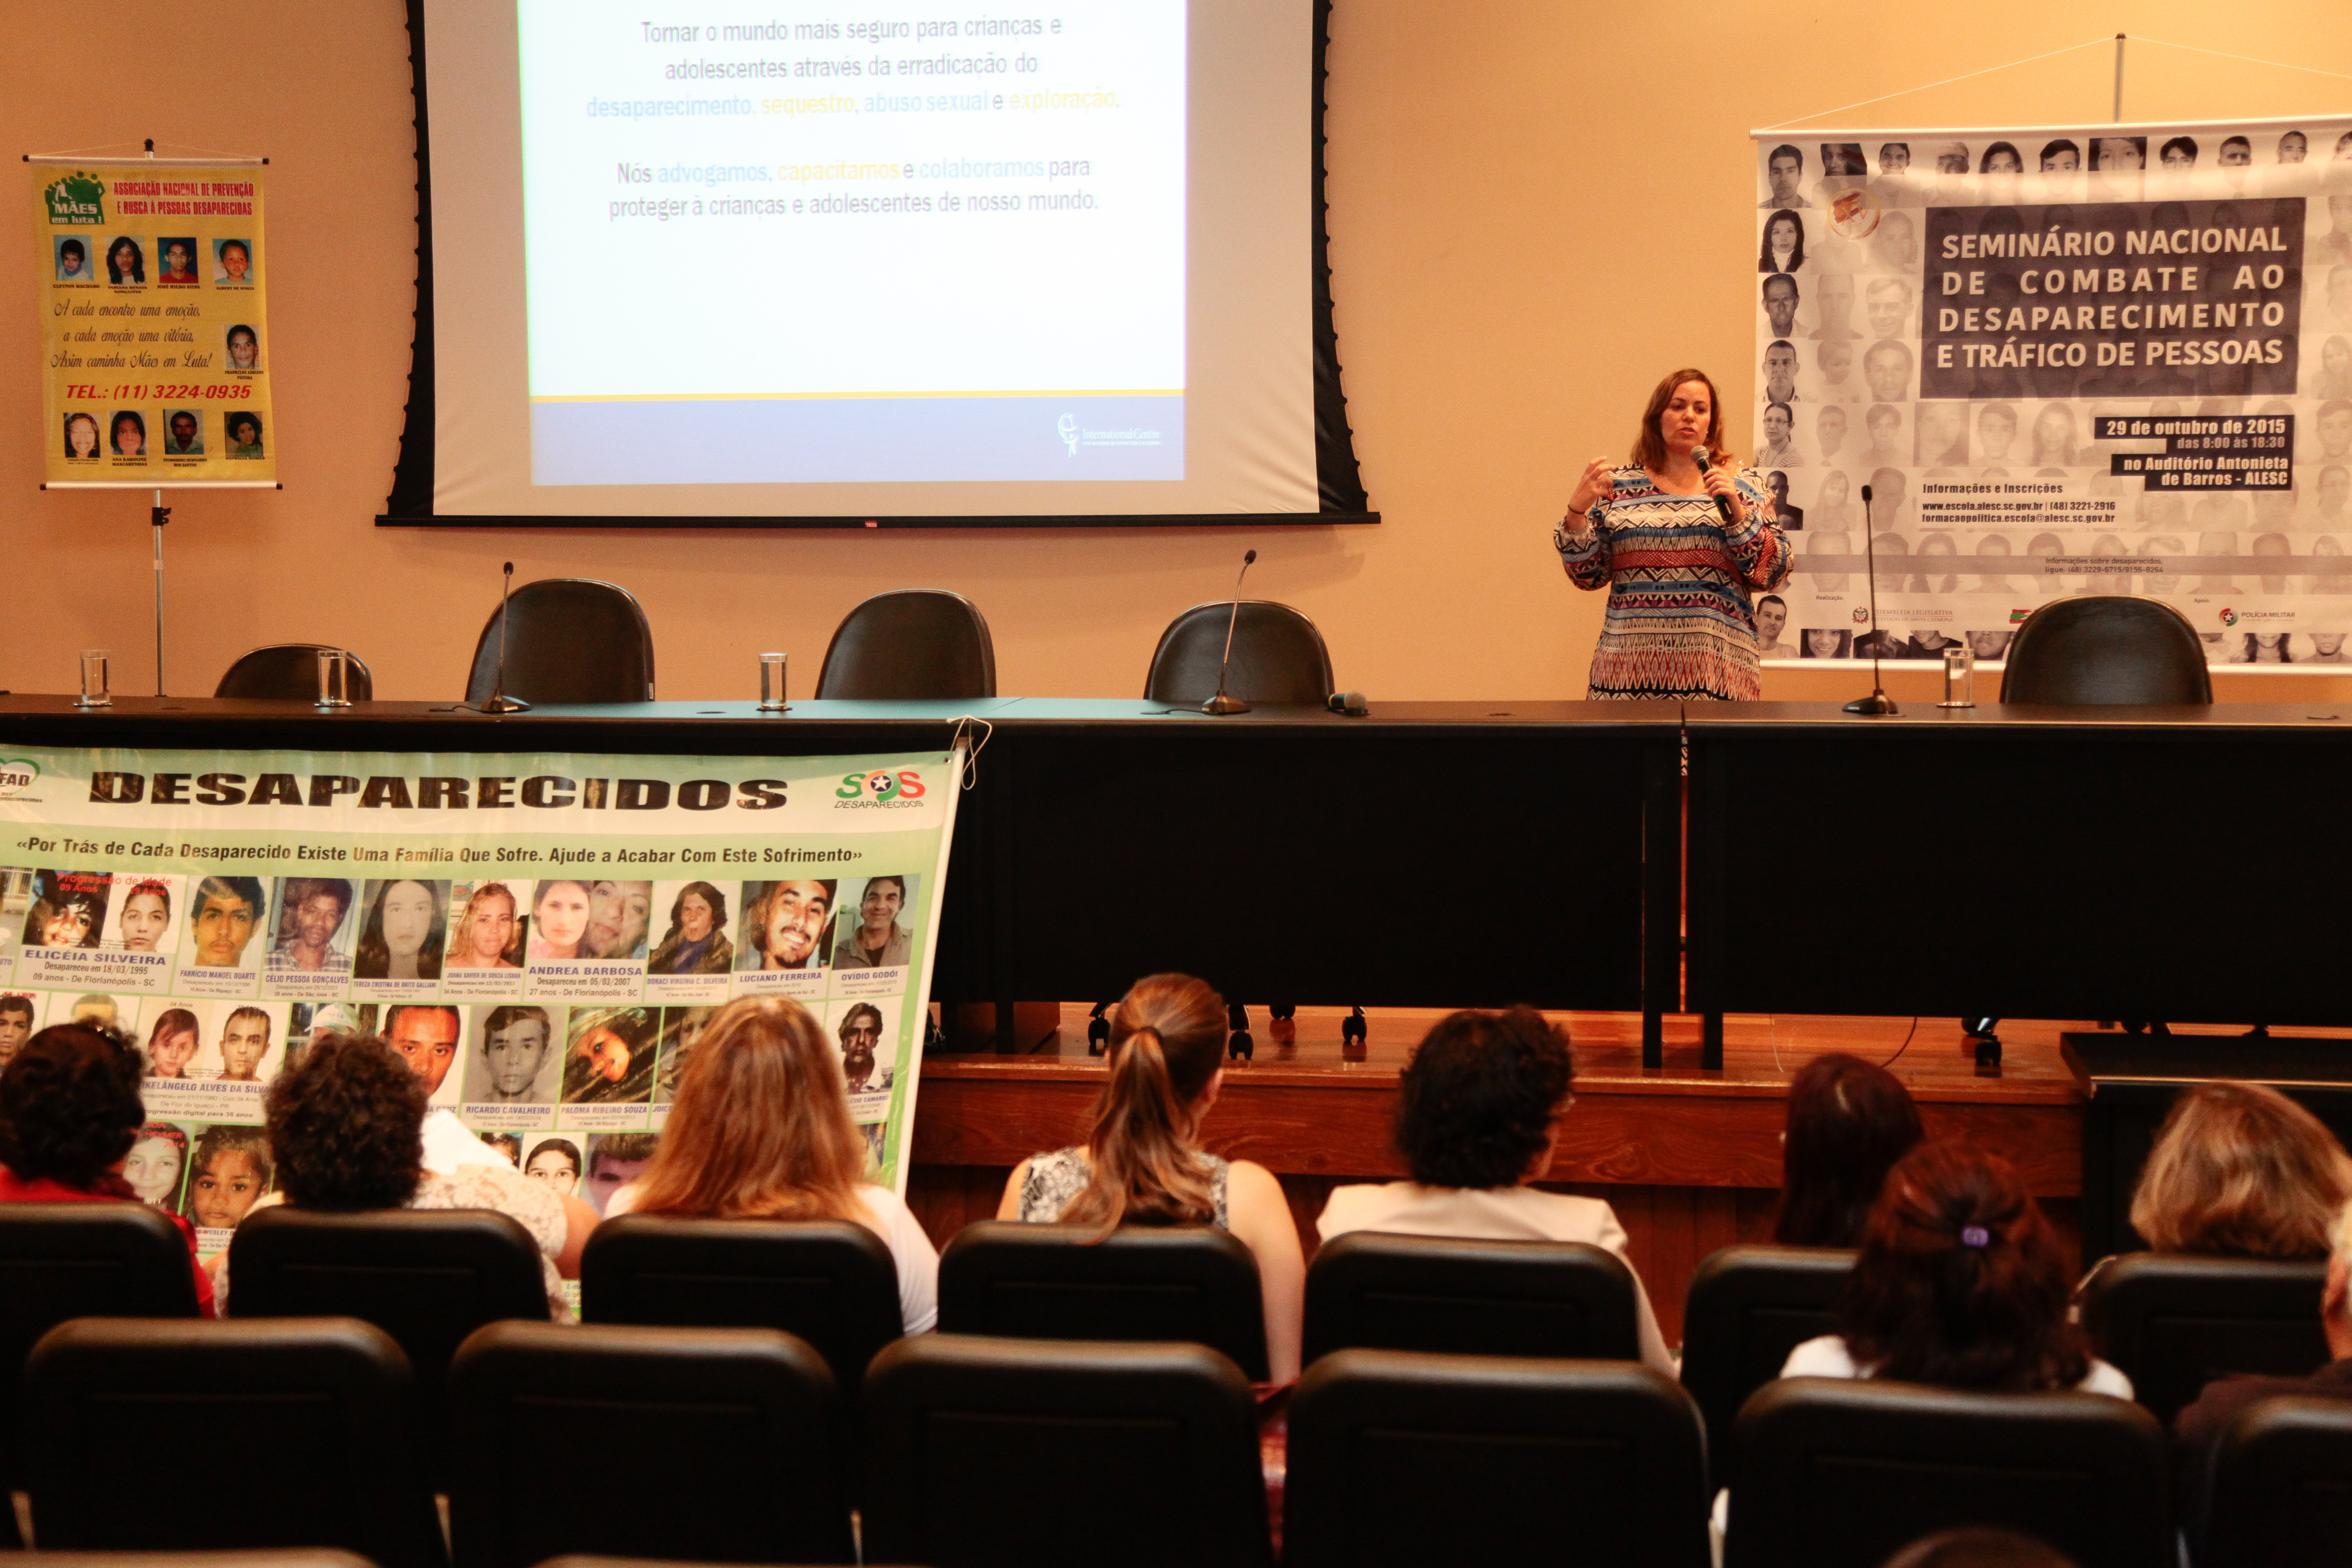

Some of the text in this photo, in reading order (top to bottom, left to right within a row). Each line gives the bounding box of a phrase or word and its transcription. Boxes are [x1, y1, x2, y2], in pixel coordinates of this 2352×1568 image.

[641, 15, 1061, 43] Tornar o mundo mais seguro para crianças e
[665, 52, 1037, 80] adolescentes através da erradicação do
[587, 86, 1119, 122] desaparecimento, sequestro, abuso sexual e exploração.
[618, 157, 1090, 187] Nós advogamos, capacitamos e colaboramos para
[114, 181, 254, 198] ASSOCIAÇÃO NACIONAL DE PREVENÇÃO
[55, 201, 97, 214] MÃES
[117, 200, 252, 215] E BUSCA À PESSOAS DESAPARECIDAS
[609, 189, 1098, 221] proteger à crianças e adolescentes de nosso mundo.
[1942, 225, 2287, 259] SEMINÁRIO NACIONAL
[1943, 264, 2284, 295] DE COMBATE AO
[55, 299, 200, 321] A cada encontro uma emoção,
[1939, 302, 2284, 332] DESAPARECIMENTO
[63, 333, 70, 342] a
[75, 326, 96, 342] cada
[102, 329, 134, 346] emoção
[139, 332, 159, 342] uma
[51, 350, 213, 368] Assim caminha Mães em Luta!
[1938, 336, 2283, 368] E TRÁFICO DE PESSOAS
[66, 385, 251, 400] TEL.: (11) 3224-0935
[1083, 428, 1160, 439] International Centre
[2107, 419, 2285, 435] 29 de outubro de 2015
[2177, 437, 2284, 449] das 8:00 às 18:30
[2124, 456, 2288, 470] no Auditório Antonieta
[2162, 471, 2287, 485] de Barros ALESC
[1923, 483, 1991, 494] Informações
[2004, 483, 2063, 494] Inscrições
[1923, 503, 2043, 511] www.escola.alesc.sc.gov.br
[2070, 501, 2115, 510] 3221-2916
[1922, 514, 2115, 524] formacaopolitica.escola@alesc.sc.gov.br
[2046, 566, 2064, 574] ligue:
[89, 771, 788, 811] DESAPARECIDOS
[834, 800, 924, 809] DESAPARECIDOS
[63, 839, 98, 854] Trás
[105, 841, 124, 855] de
[131, 842, 174, 857] Cada
[180, 844, 291, 861] Desaparecido
[298, 845, 346, 861] Existe
[353, 847, 388, 862] Uma
[395, 847, 454, 862] Família
[460, 848, 490, 863] Que
[496, 847, 542, 862] Sofre.
[549, 848, 595, 865] Ajude
[602, 851, 611, 862] a
[617, 849, 675, 862] Acabar
[682, 849, 716, 862] Com
[723, 848, 757, 862] Este
[57, 873, 171, 886] Progressão de Idade
[25, 950, 166, 965] ELICÉIA SILVEIRA
[45, 962, 89, 973] Desapareceu
[103, 965, 147, 974] 18/03/1995
[85, 976, 135, 986] Florianópolis
